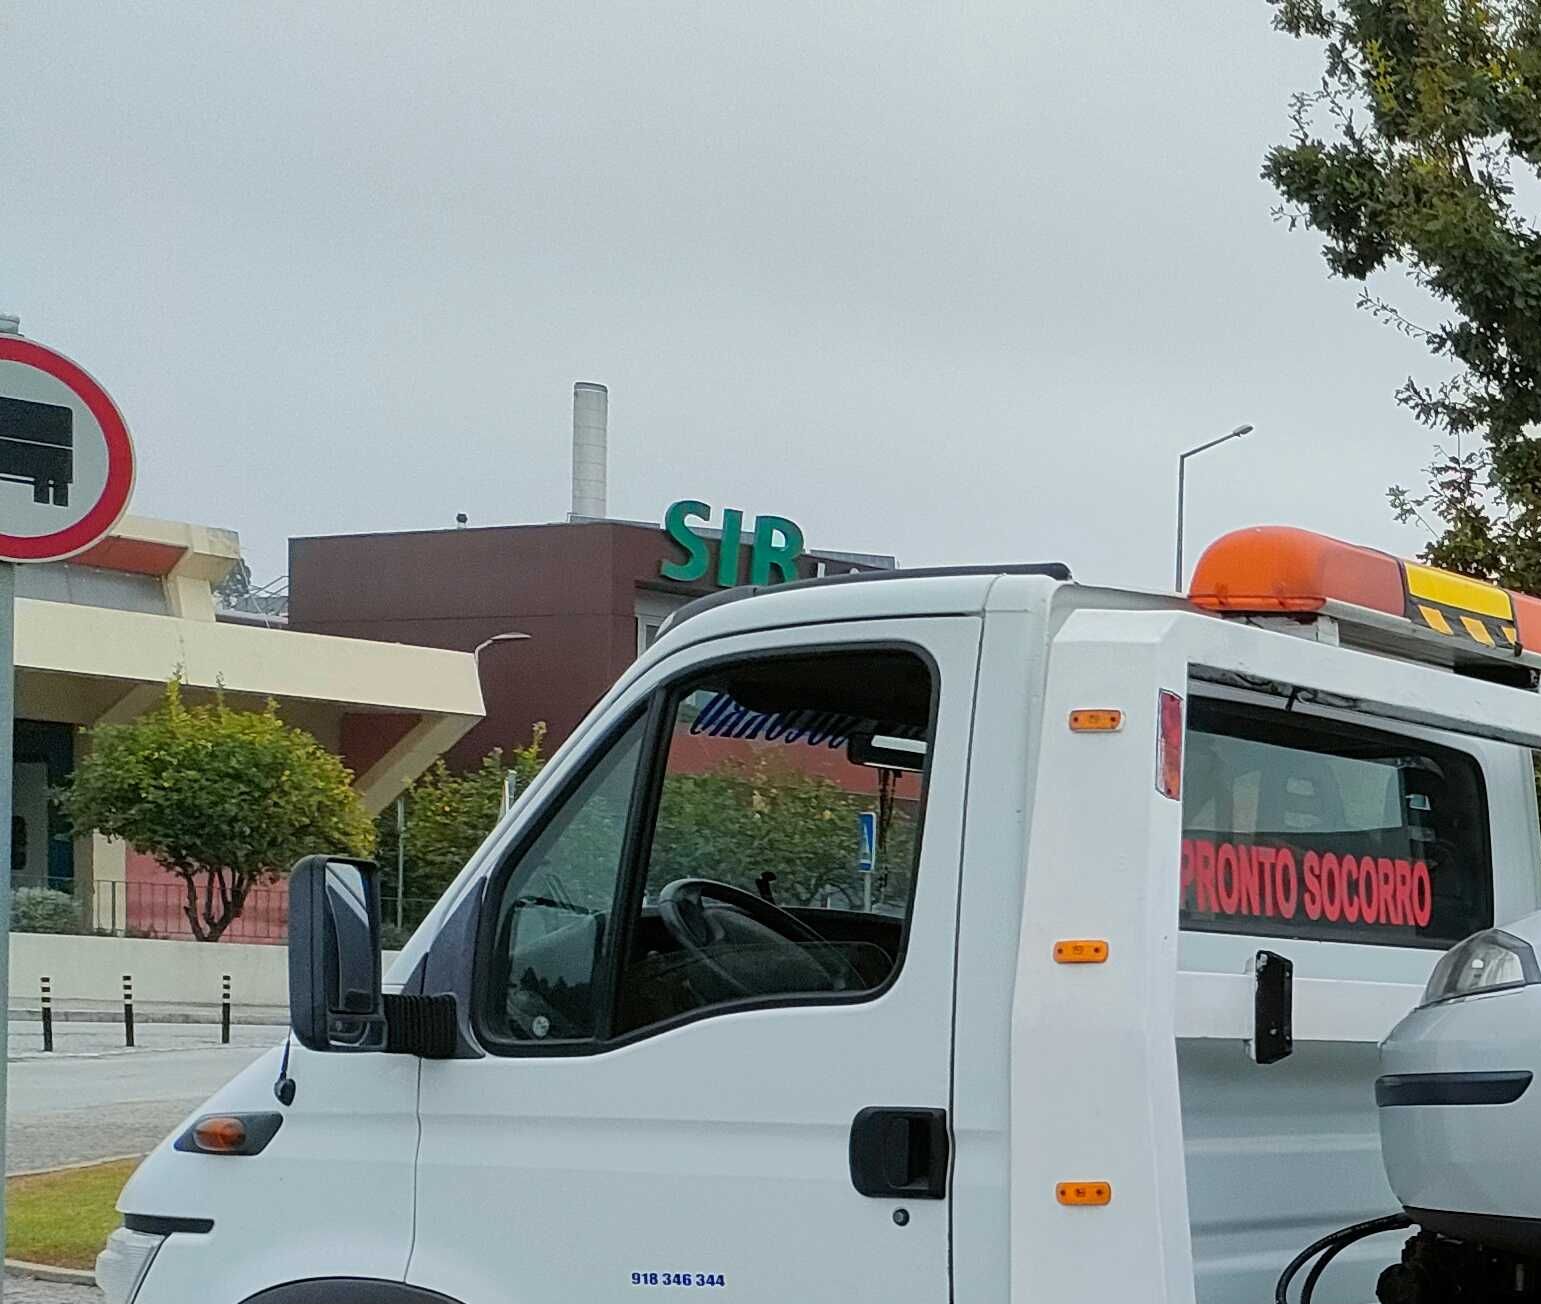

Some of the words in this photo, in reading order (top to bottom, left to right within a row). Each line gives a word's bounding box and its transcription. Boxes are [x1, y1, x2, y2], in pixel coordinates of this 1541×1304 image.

[661, 500, 804, 587] SIR
[1180, 839, 1297, 919] PRONTO
[1303, 850, 1431, 927] SOCORRO
[631, 1272, 659, 1286] 918
[662, 1272, 693, 1287] 346
[695, 1273, 726, 1287] 344
